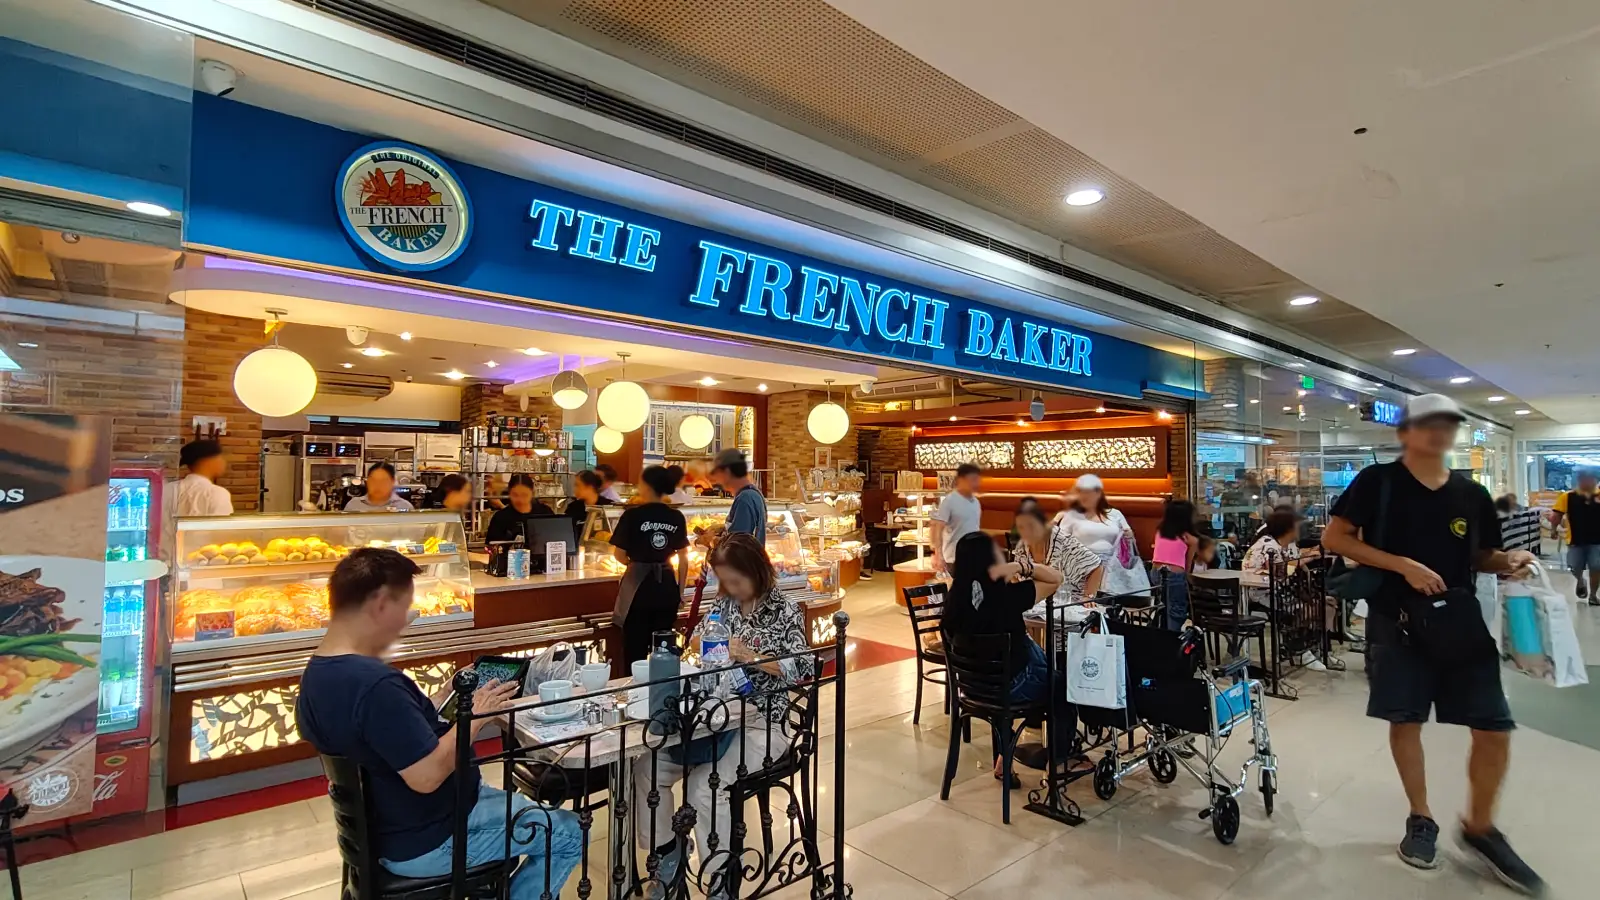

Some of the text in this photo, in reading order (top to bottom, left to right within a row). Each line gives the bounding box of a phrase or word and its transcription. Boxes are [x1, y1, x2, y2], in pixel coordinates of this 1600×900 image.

[396, 154, 436, 175] ORIGINAL
[350, 207, 445, 225] THE FRENCH
[377, 227, 442, 251] BAKER
[530, 199, 1093, 377] THE FRENCH BAKER
